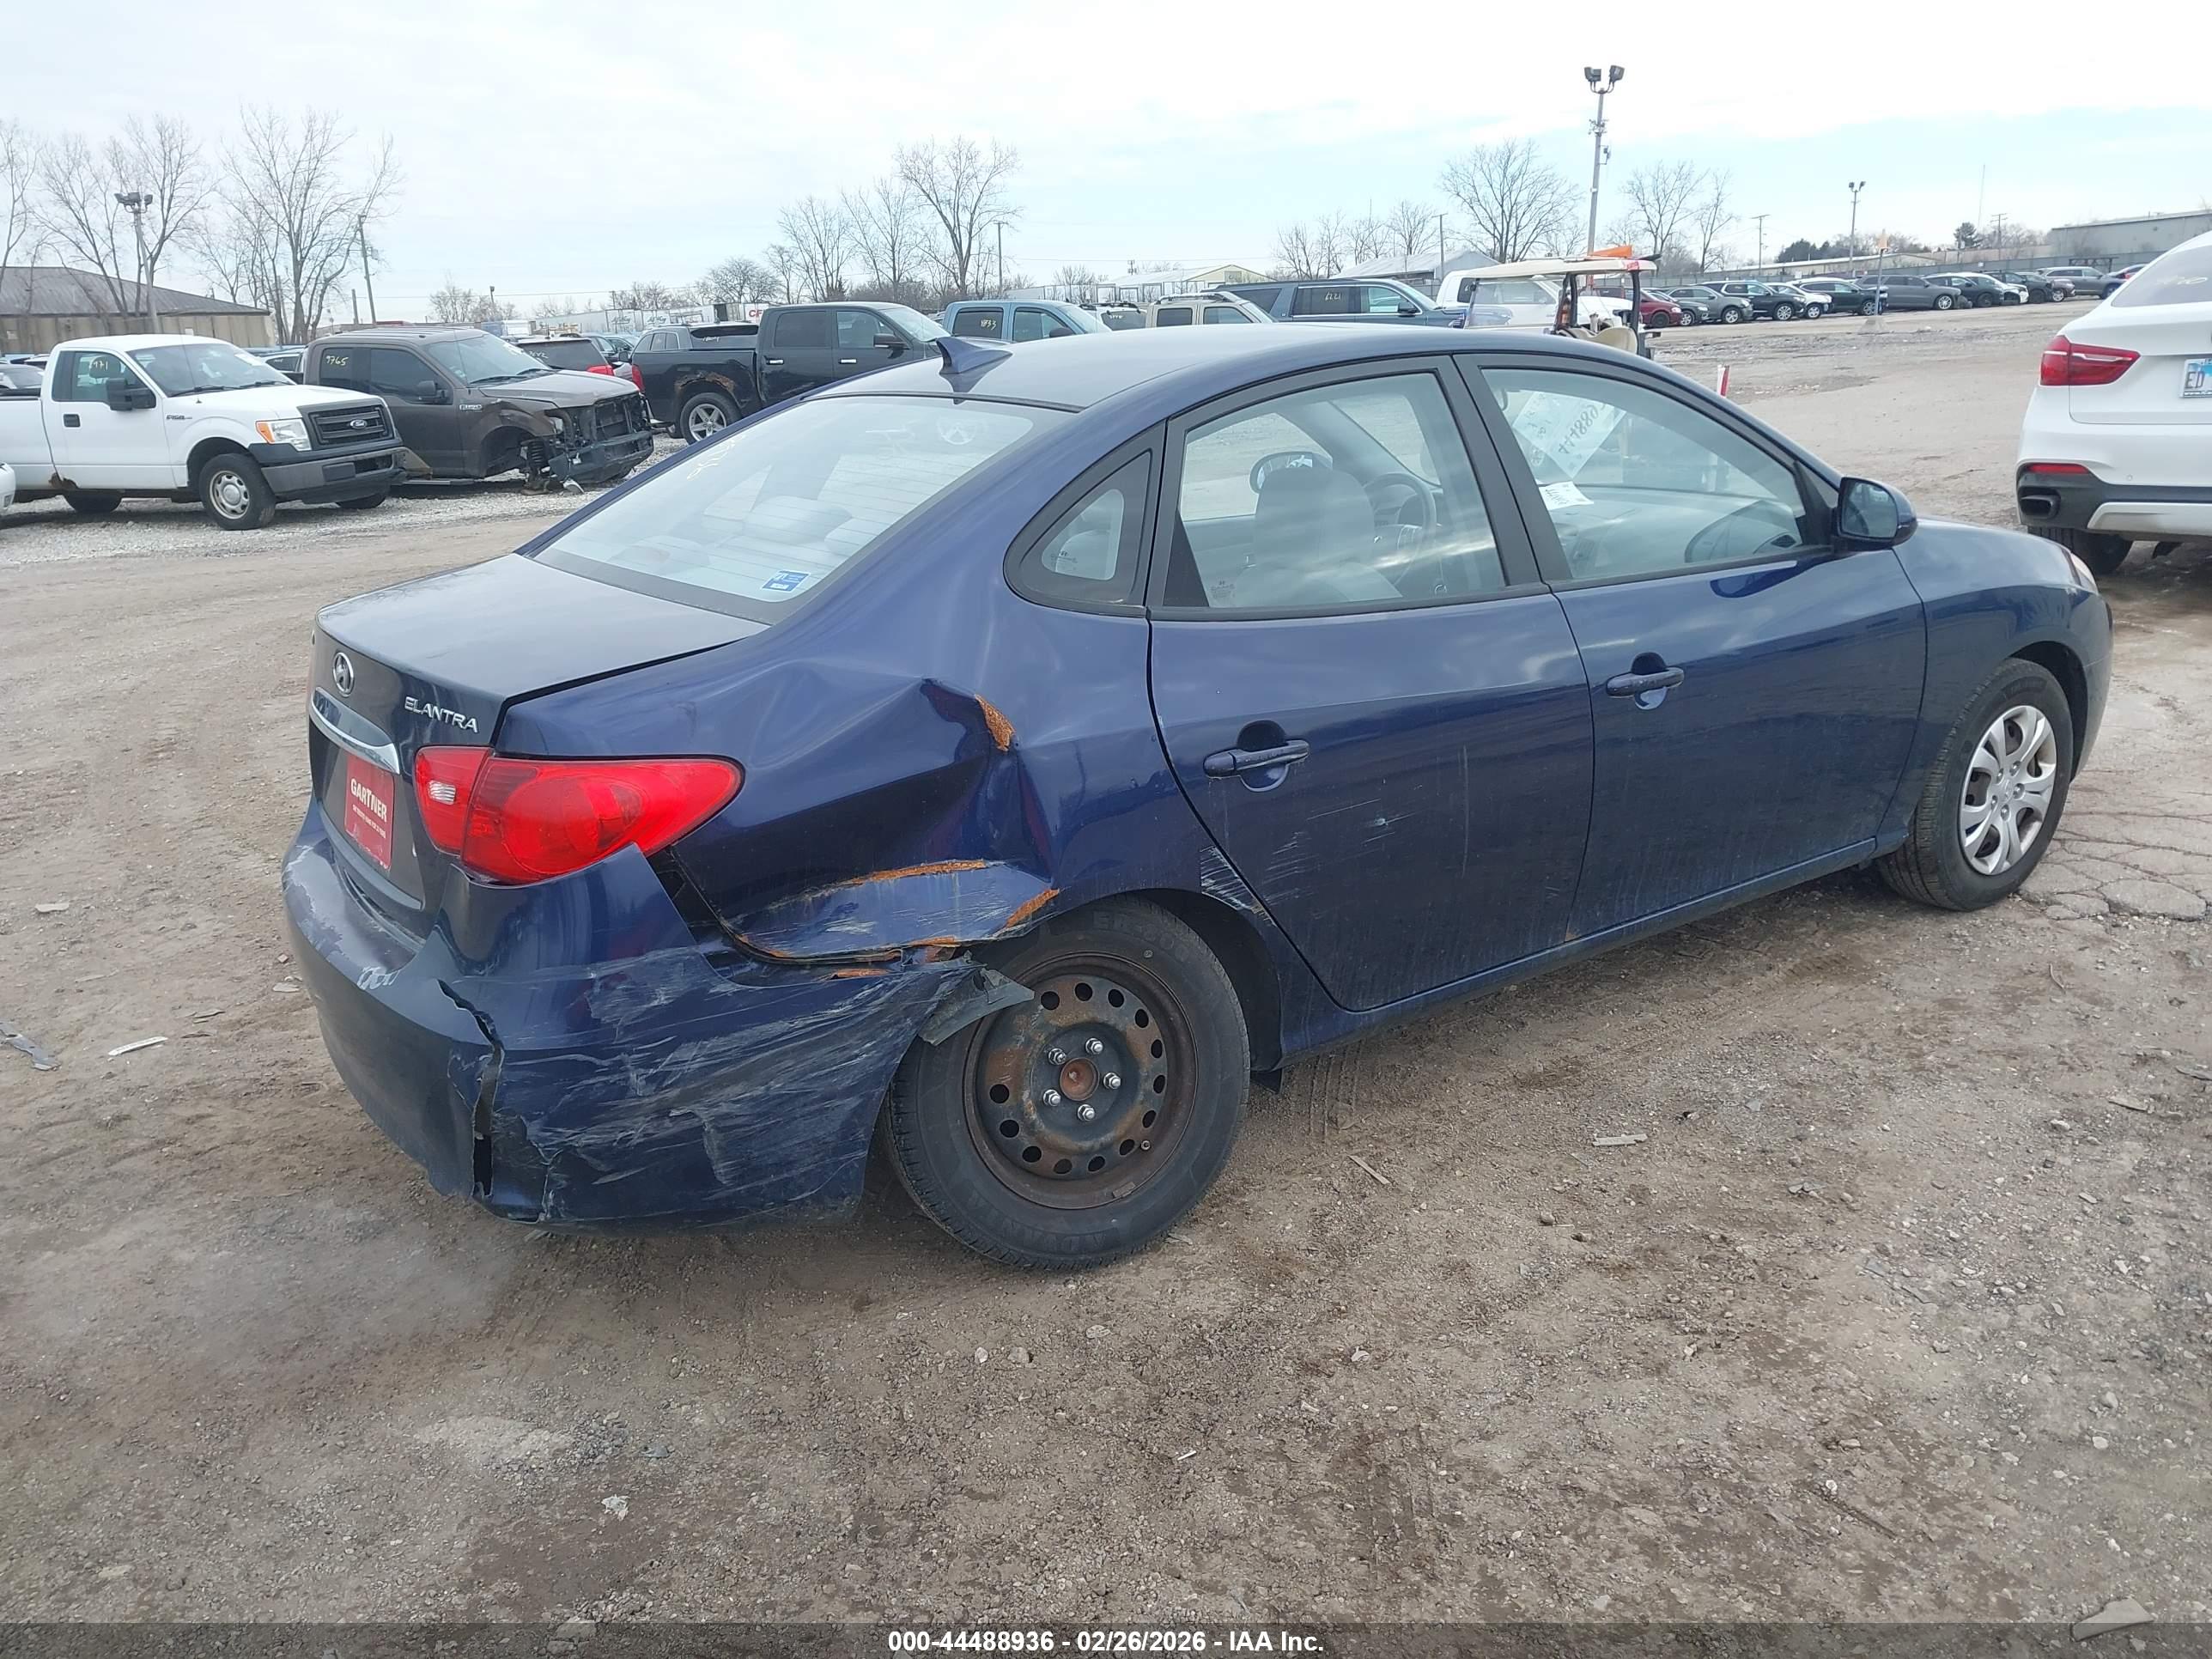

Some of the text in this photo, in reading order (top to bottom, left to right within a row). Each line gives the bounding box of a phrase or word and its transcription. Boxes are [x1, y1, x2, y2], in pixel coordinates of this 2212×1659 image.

[2185, 371, 2205, 389] ED
[404, 696, 478, 733] ELANTRA
[349, 777, 388, 823] GARTNER
